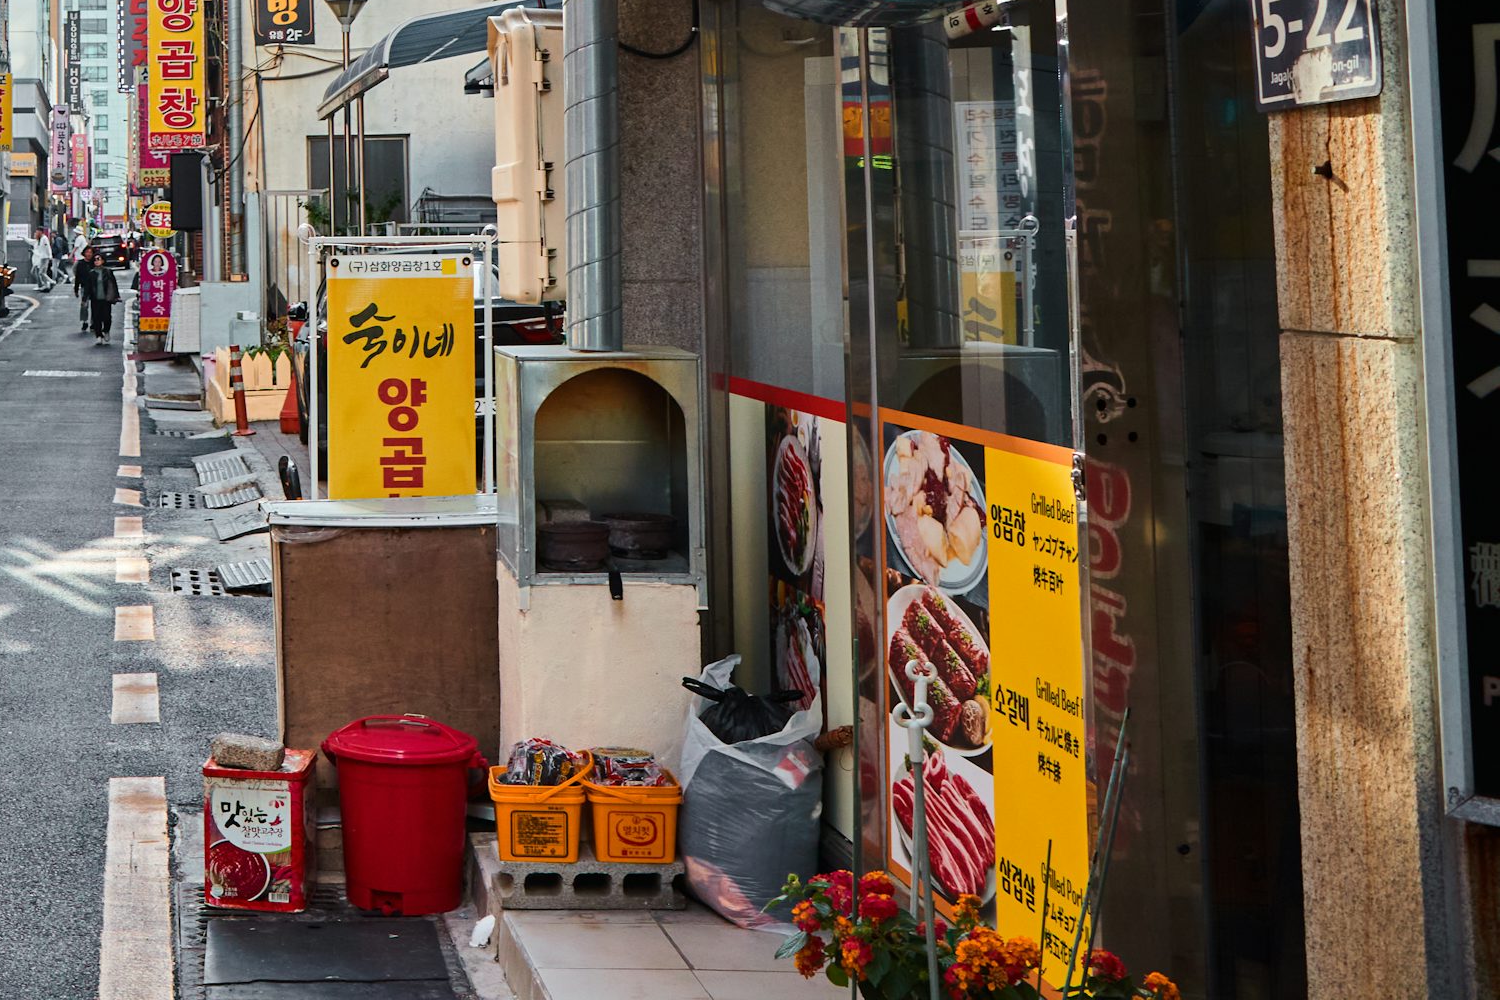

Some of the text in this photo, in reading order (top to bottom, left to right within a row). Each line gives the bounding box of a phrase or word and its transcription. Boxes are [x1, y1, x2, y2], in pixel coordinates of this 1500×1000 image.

[286, 28, 302, 42] 2F
[69, 68, 79, 112] HOTEL
[56, 122, 67, 156] 따뜻한
[342, 302, 455, 369] 숙이네
[377, 377, 428, 498] 양곱
[991, 503, 1026, 547] 양곱창
[1031, 492, 1075, 524] Grilled Beef
[995, 684, 1029, 731] 소갈비
[1035, 676, 1080, 718] Grilled Beef
[1037, 716, 1080, 759] 牛カルビ焼き
[220, 800, 268, 829] 맛있는
[241, 826, 283, 839] 찰맛고추장
[1000, 856, 1036, 913] 삼겹살
